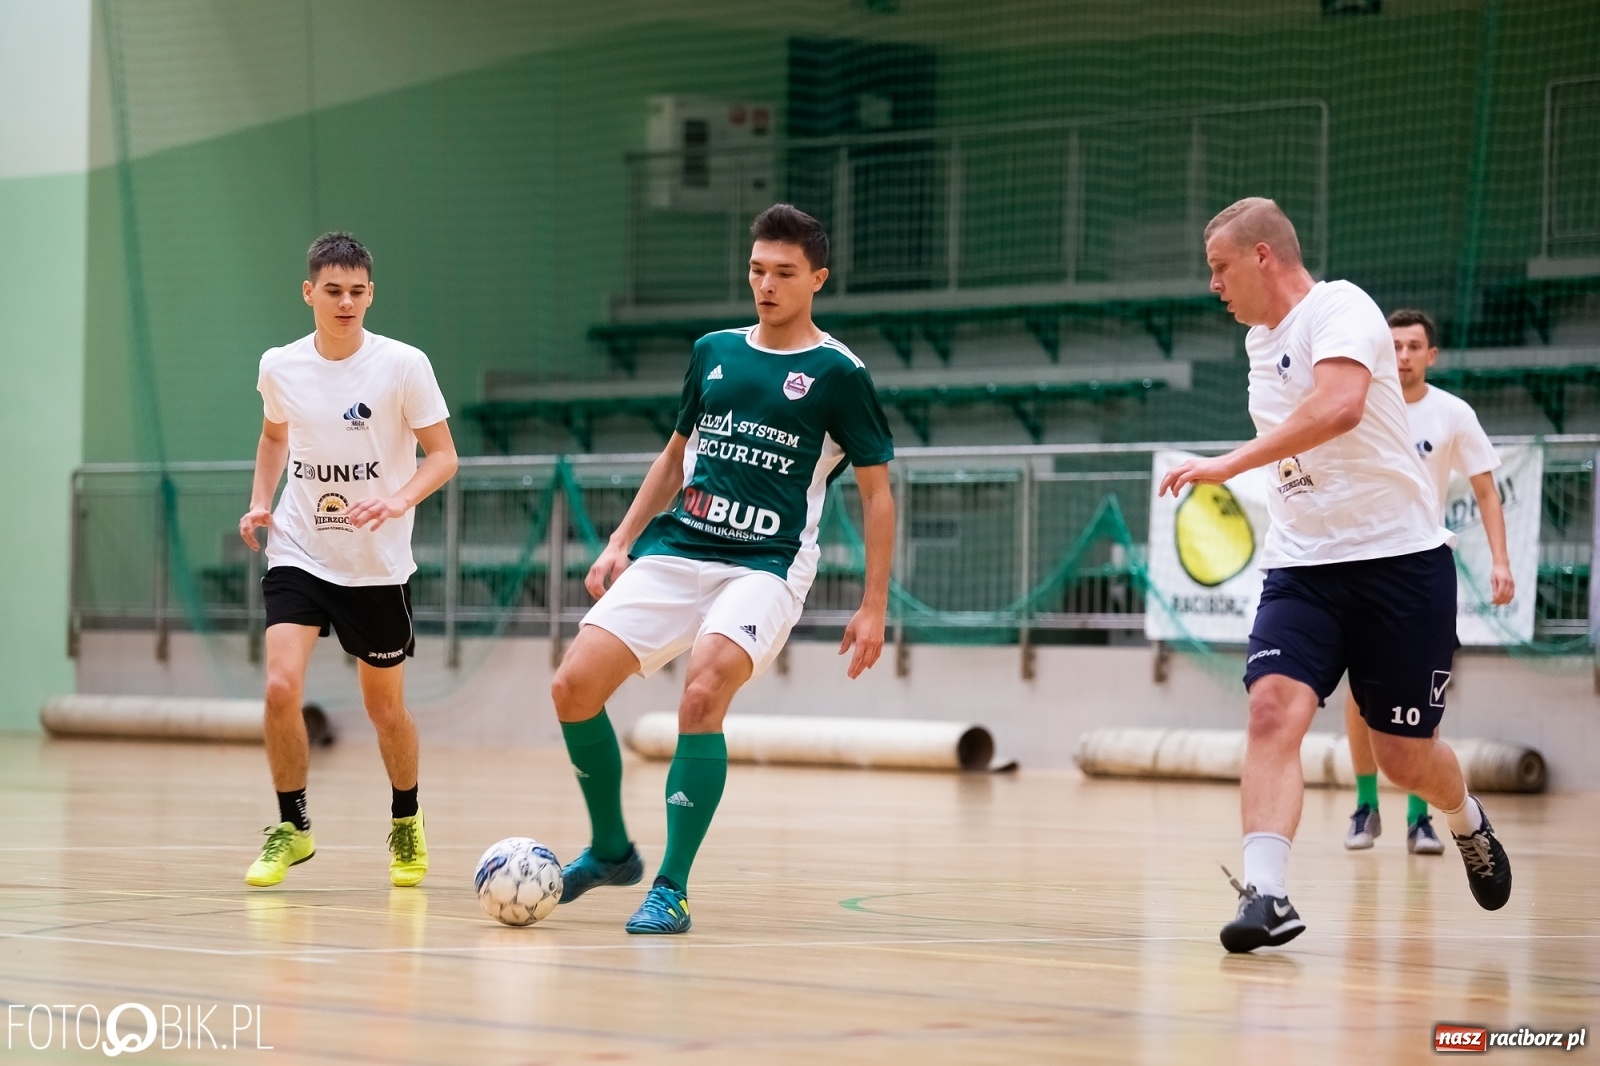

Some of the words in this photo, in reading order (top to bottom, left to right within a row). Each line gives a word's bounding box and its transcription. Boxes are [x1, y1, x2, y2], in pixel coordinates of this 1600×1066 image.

[696, 438, 795, 475] ECURITY
[293, 460, 380, 483] ZDUNEK
[1391, 706, 1421, 726] 10
